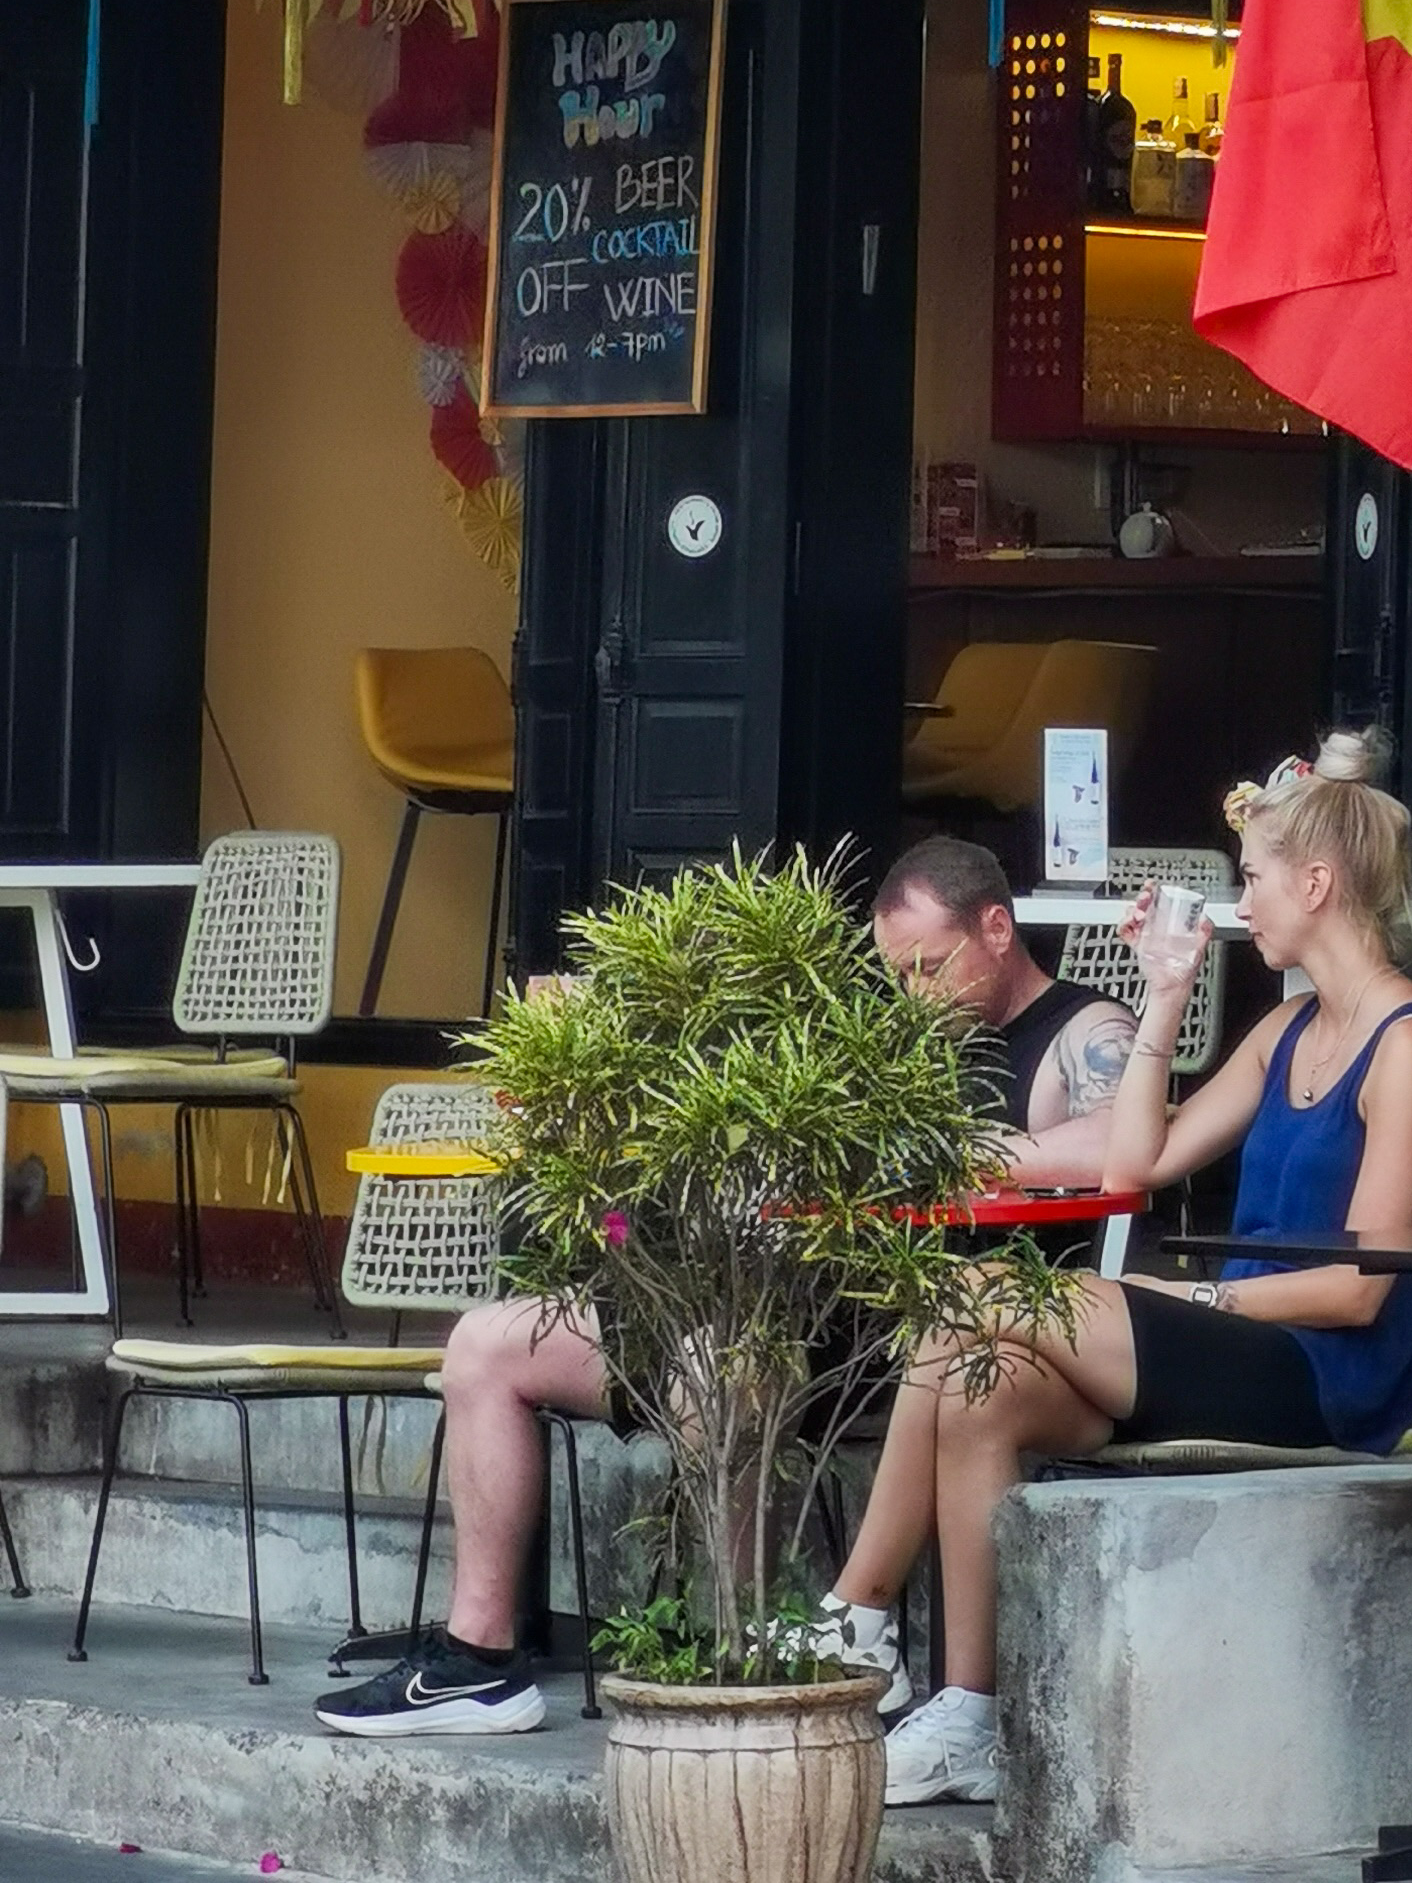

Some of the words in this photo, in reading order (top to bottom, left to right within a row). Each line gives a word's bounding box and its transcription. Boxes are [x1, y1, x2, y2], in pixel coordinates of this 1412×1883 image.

[558, 84, 667, 150] Hour
[512, 175, 593, 244] 20%
[614, 155, 700, 214] BEER
[592, 213, 700, 264] COCKTAIL
[517, 258, 590, 317] OFF
[603, 271, 698, 322] WINE
[517, 335, 569, 379] from
